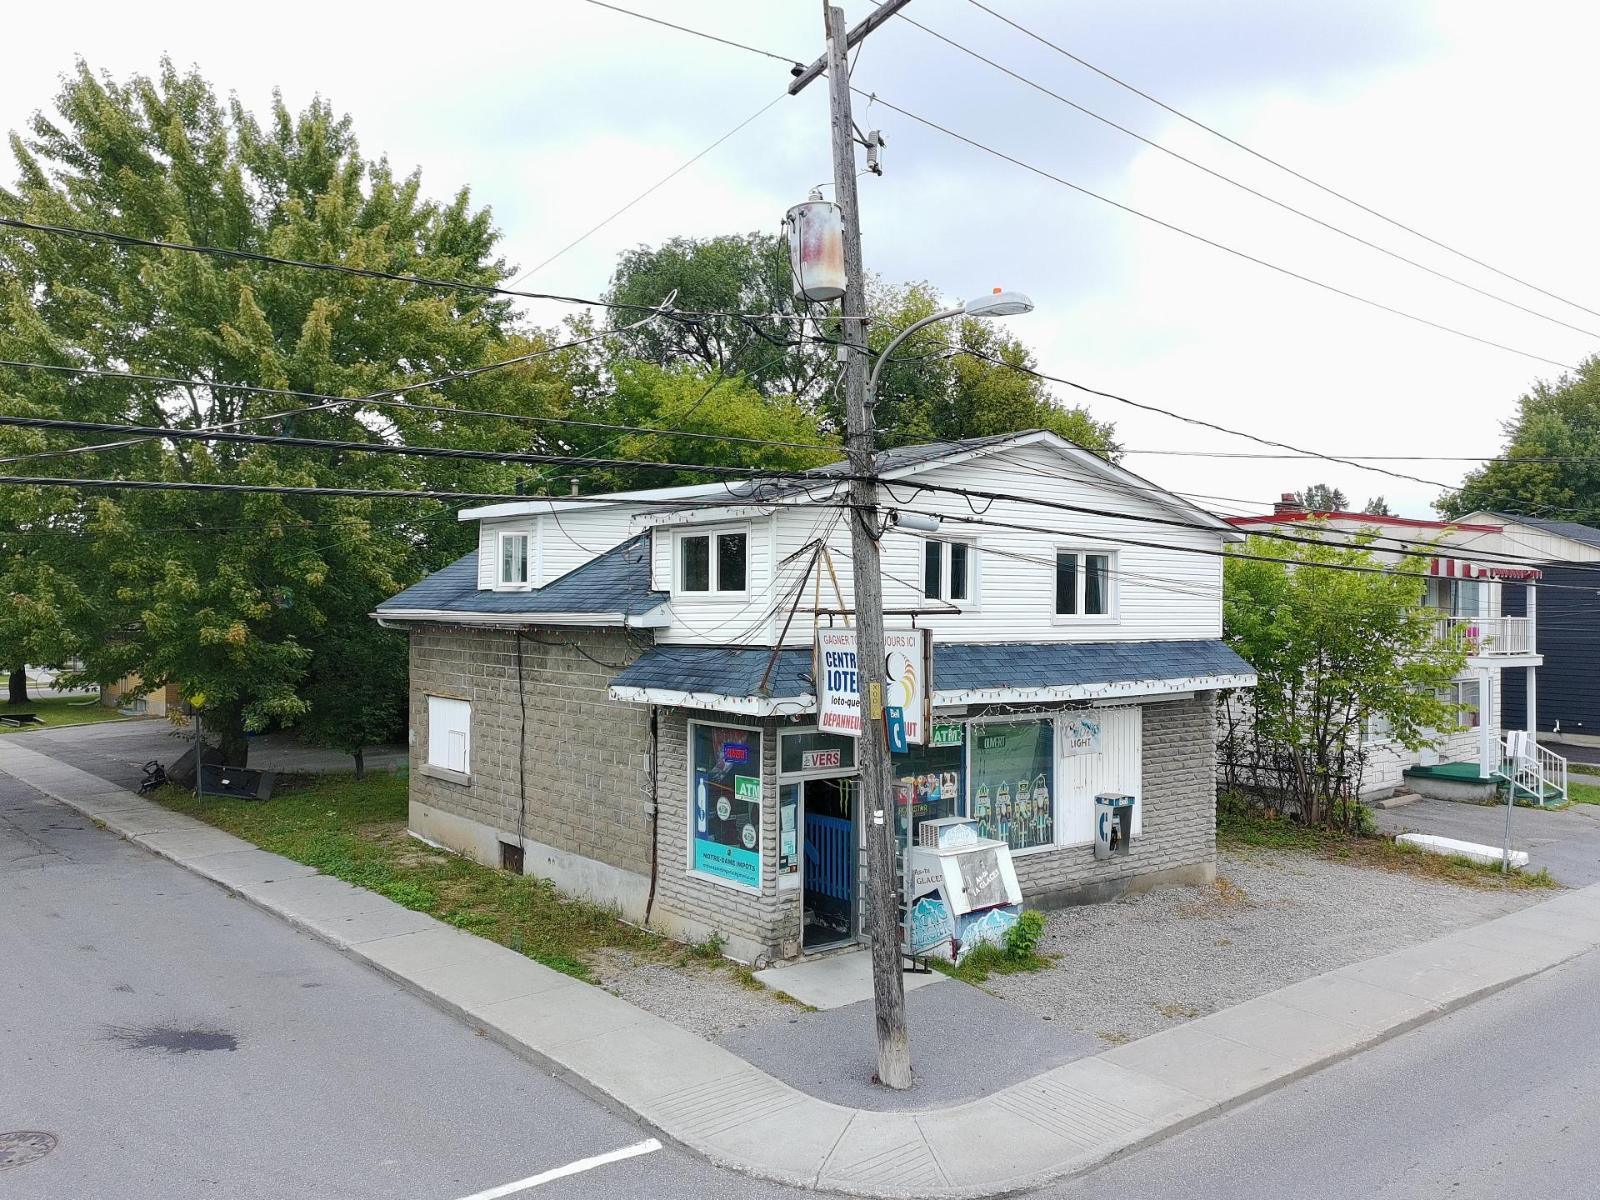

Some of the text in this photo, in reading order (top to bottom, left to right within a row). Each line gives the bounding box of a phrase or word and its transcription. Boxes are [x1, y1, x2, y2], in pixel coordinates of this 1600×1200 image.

[823, 635, 848, 645] GAGNER
[907, 637, 916, 647] ICI
[826, 651, 857, 669] CENTR
[828, 670, 860, 693] LOTE
[831, 695, 860, 708] loto-que
[934, 729, 958, 743] ATM
[1071, 739, 1091, 752] LIGHT
[812, 753, 839, 766] VERS
